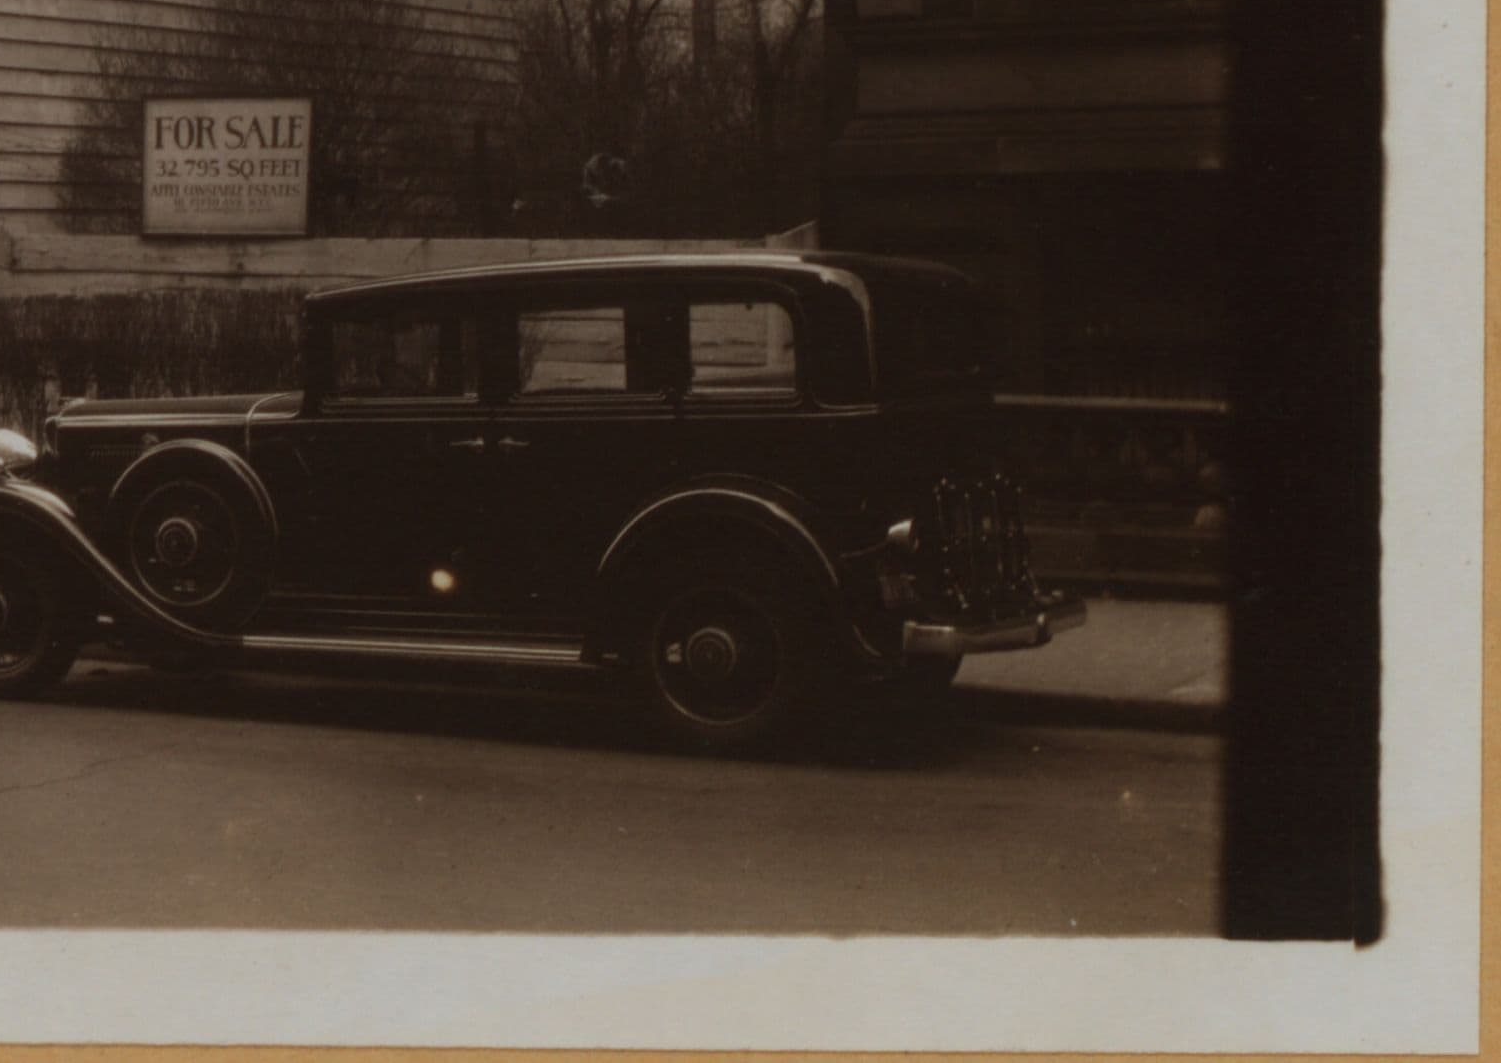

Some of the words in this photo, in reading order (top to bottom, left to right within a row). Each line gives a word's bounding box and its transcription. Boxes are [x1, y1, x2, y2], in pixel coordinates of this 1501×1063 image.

[155, 115, 218, 150] FOR
[225, 115, 304, 150] SALE
[259, 159, 302, 177] FEET
[151, 184, 180, 197] APPLY
[247, 184, 301, 197] ESTATES
